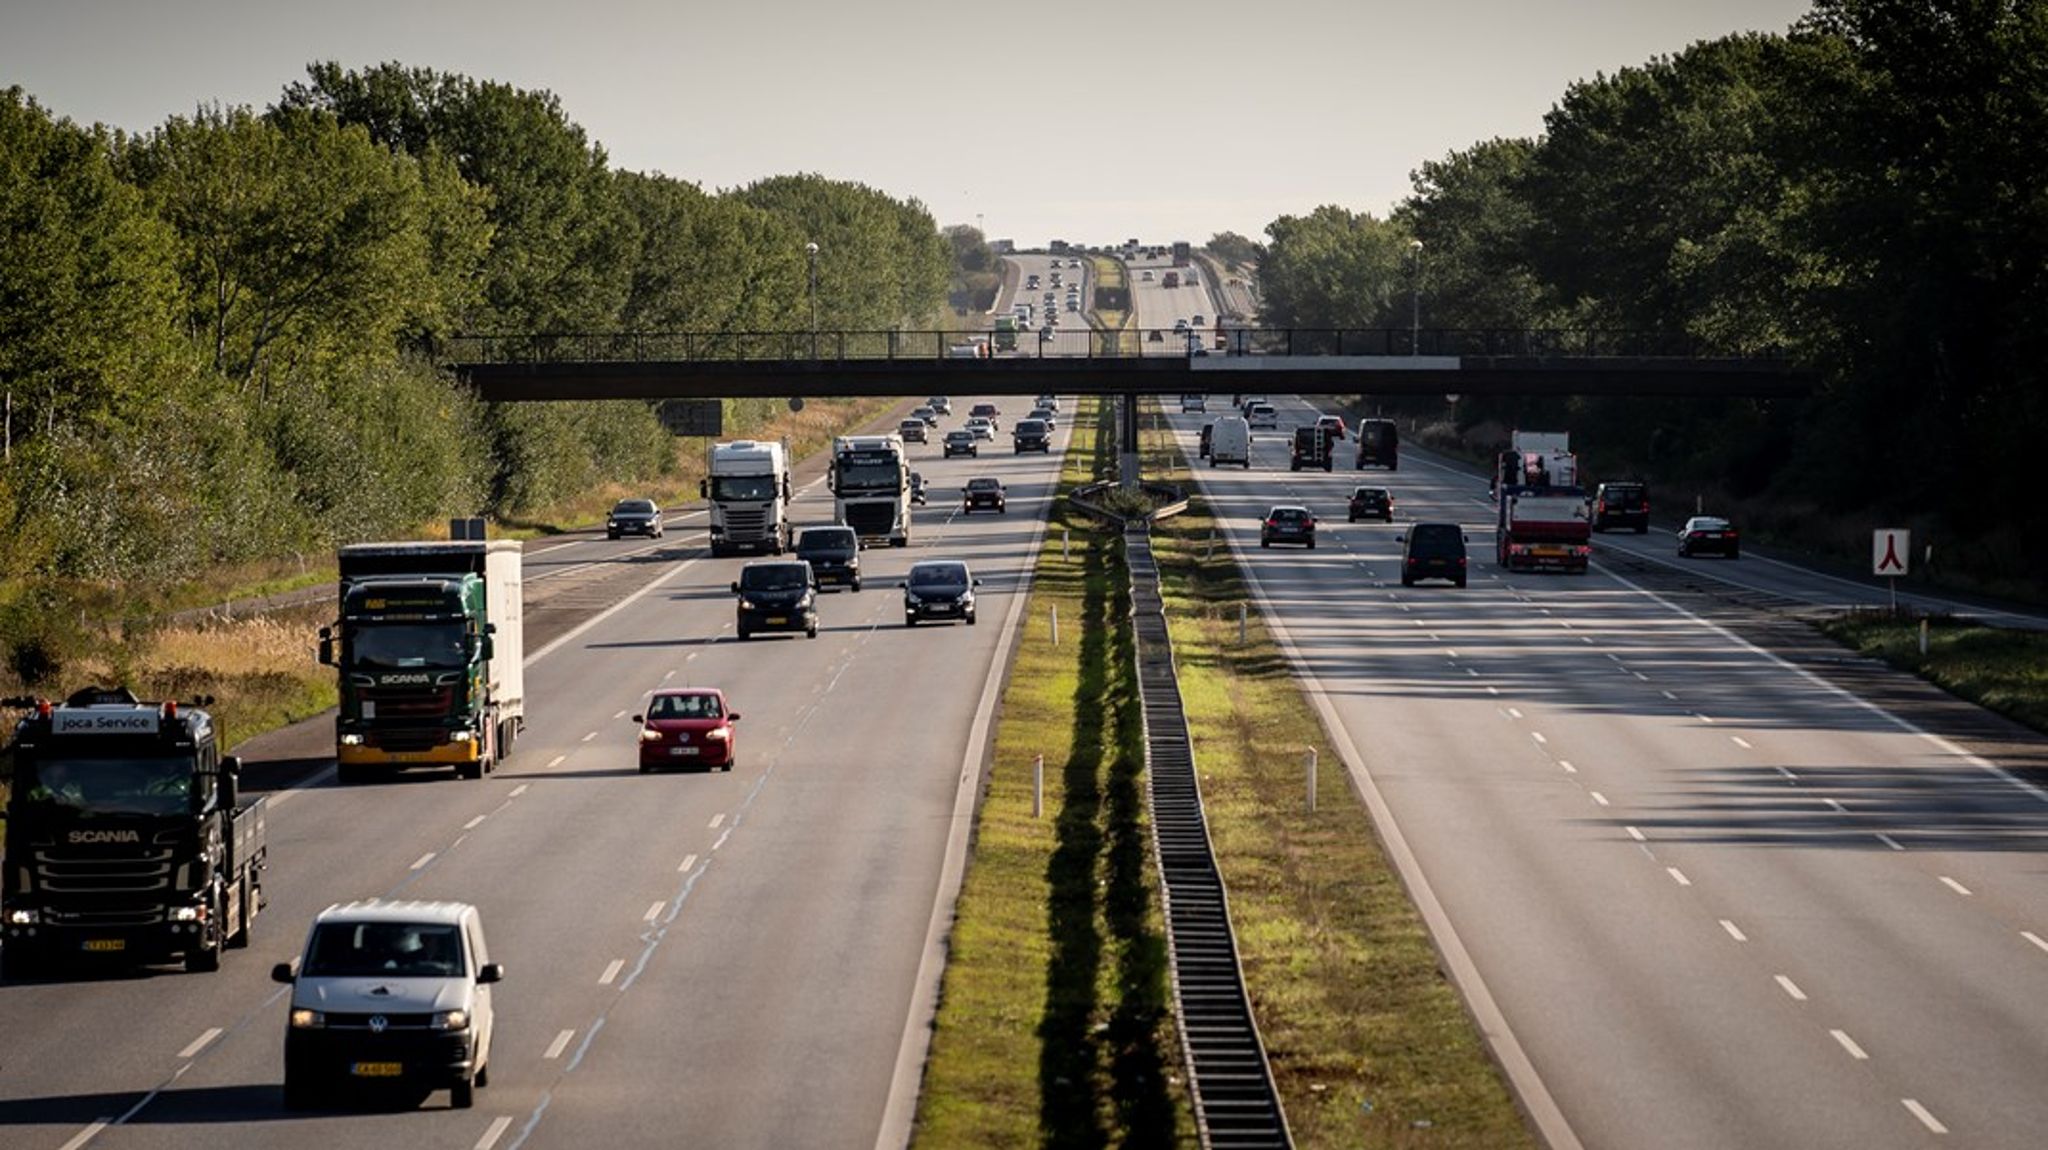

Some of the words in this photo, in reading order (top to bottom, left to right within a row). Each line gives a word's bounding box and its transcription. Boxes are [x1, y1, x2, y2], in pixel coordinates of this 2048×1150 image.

[381, 674, 429, 684] SCANIA
[97, 716, 149, 729] Service
[68, 830, 139, 843] SCANIA
